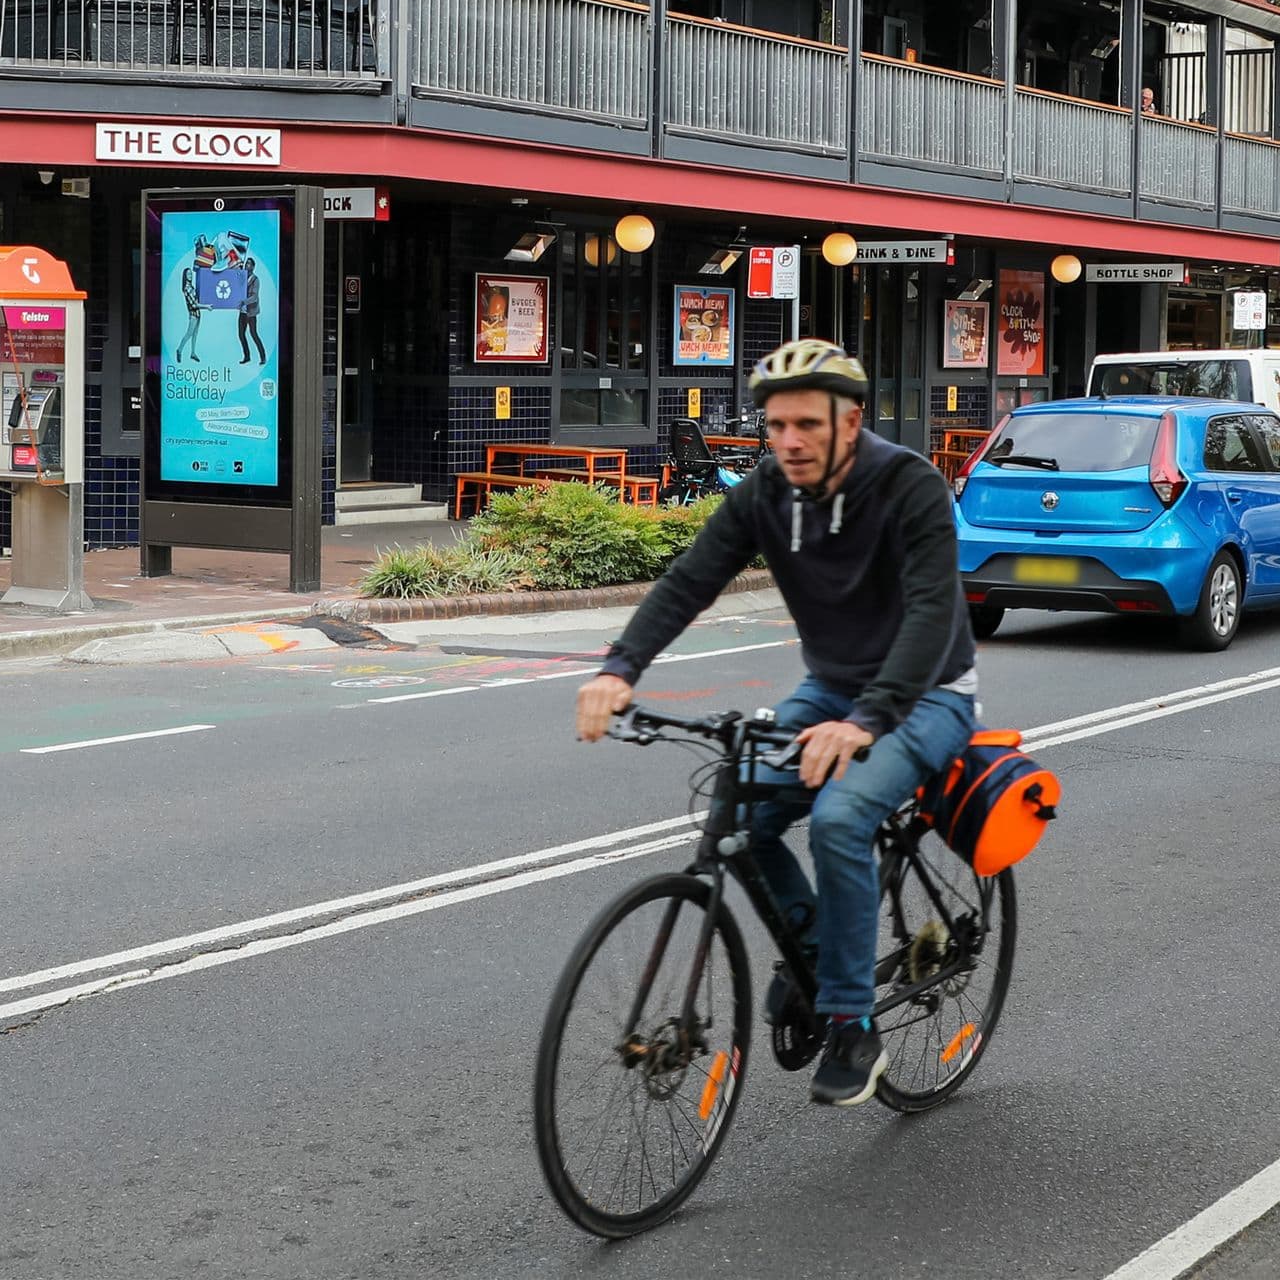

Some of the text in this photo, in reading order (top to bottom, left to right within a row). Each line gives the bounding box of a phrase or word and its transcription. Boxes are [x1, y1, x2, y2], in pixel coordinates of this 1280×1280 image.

[104, 130, 273, 158] THE CLOCK
[324, 196, 352, 211] OCK
[856, 247, 936, 259] RINK & DINE
[1096, 269, 1174, 279] BOTTLE SHOP
[511, 298, 537, 307] BURGER
[680, 298, 725, 310] LUNCH MENU
[518, 307, 535, 316] BEER
[1001, 304, 1024, 317] CLOCK
[21, 312, 50, 322] Telstra
[1023, 330, 1041, 343] SHOP
[680, 342, 700, 352] UNCH
[166, 365, 232, 385] Recycle It
[166, 382, 226, 404] Saturday
